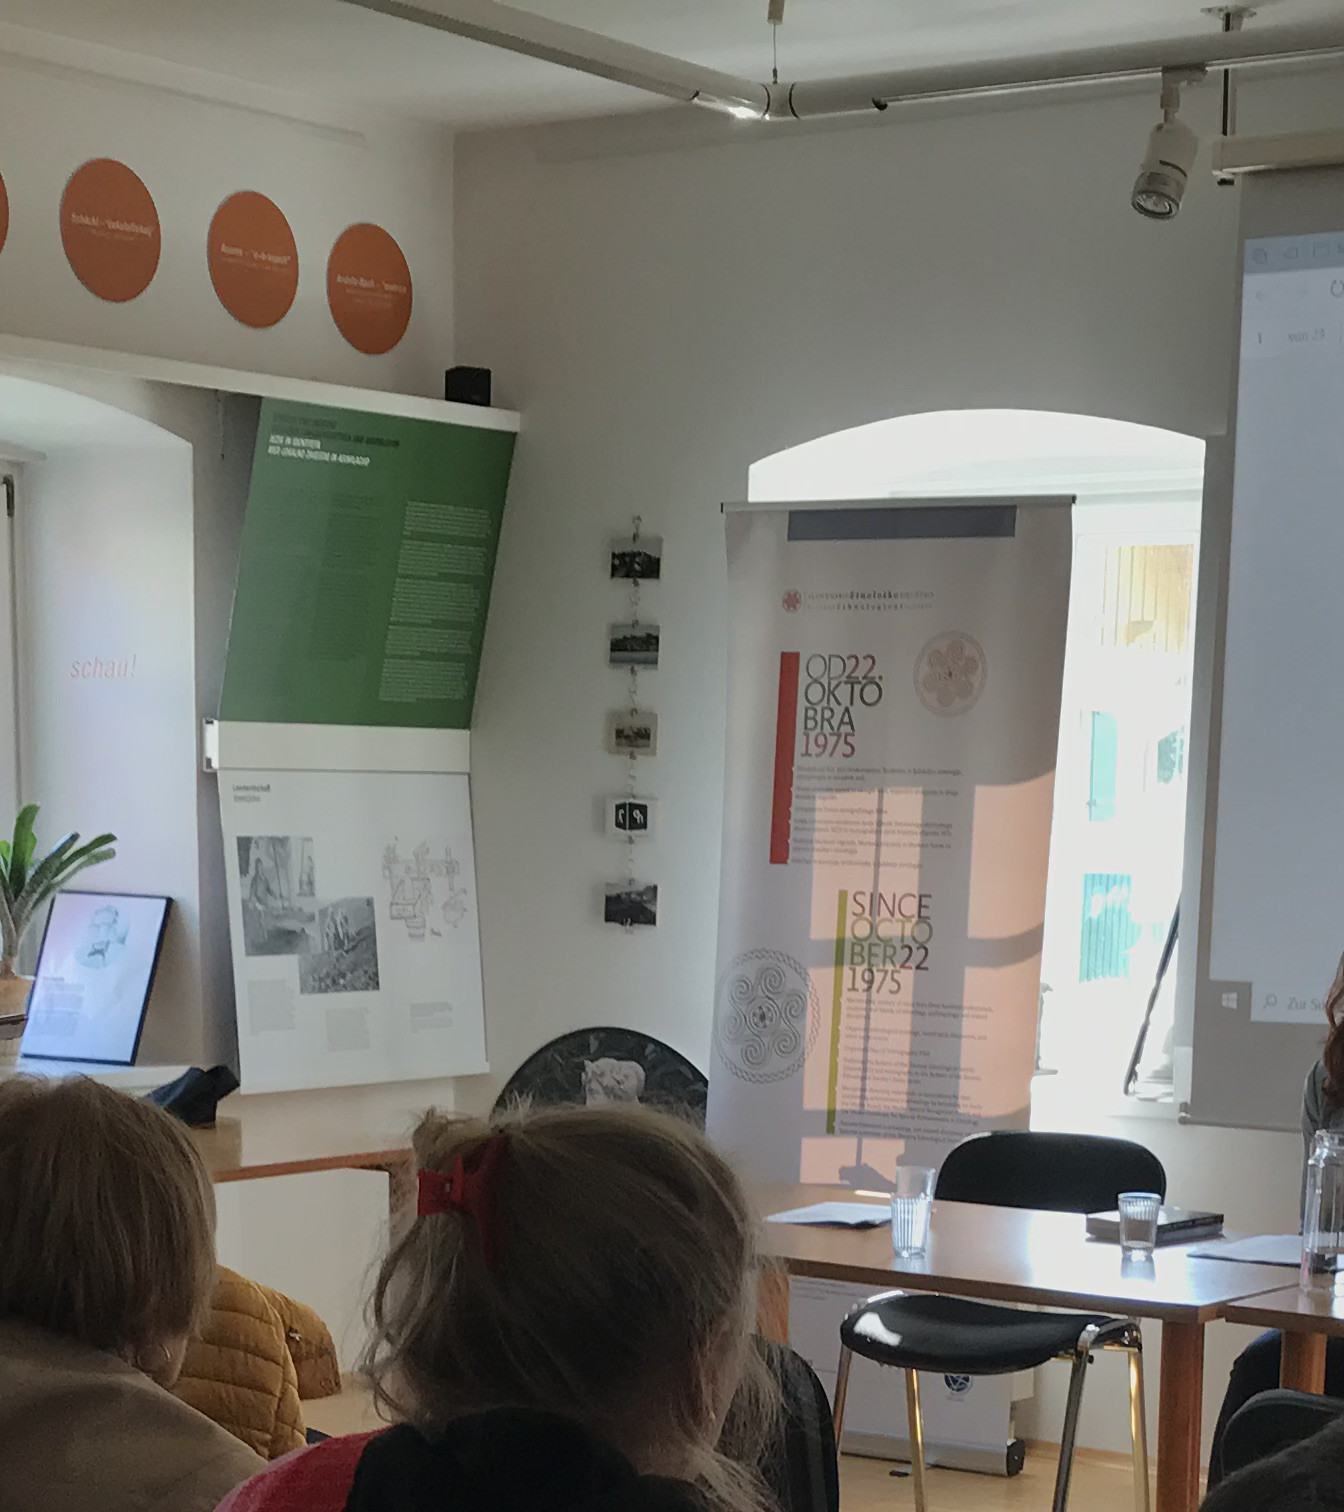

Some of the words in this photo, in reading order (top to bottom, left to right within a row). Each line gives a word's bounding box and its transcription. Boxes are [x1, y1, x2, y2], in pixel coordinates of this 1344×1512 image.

[70, 653, 137, 679] schau!
[804, 680, 883, 707] OKTO
[803, 706, 855, 733] BRA
[800, 732, 856, 758] 1975
[851, 890, 933, 920] SINCE
[851, 916, 933, 945] OCTO
[846, 966, 902, 995] 1975
